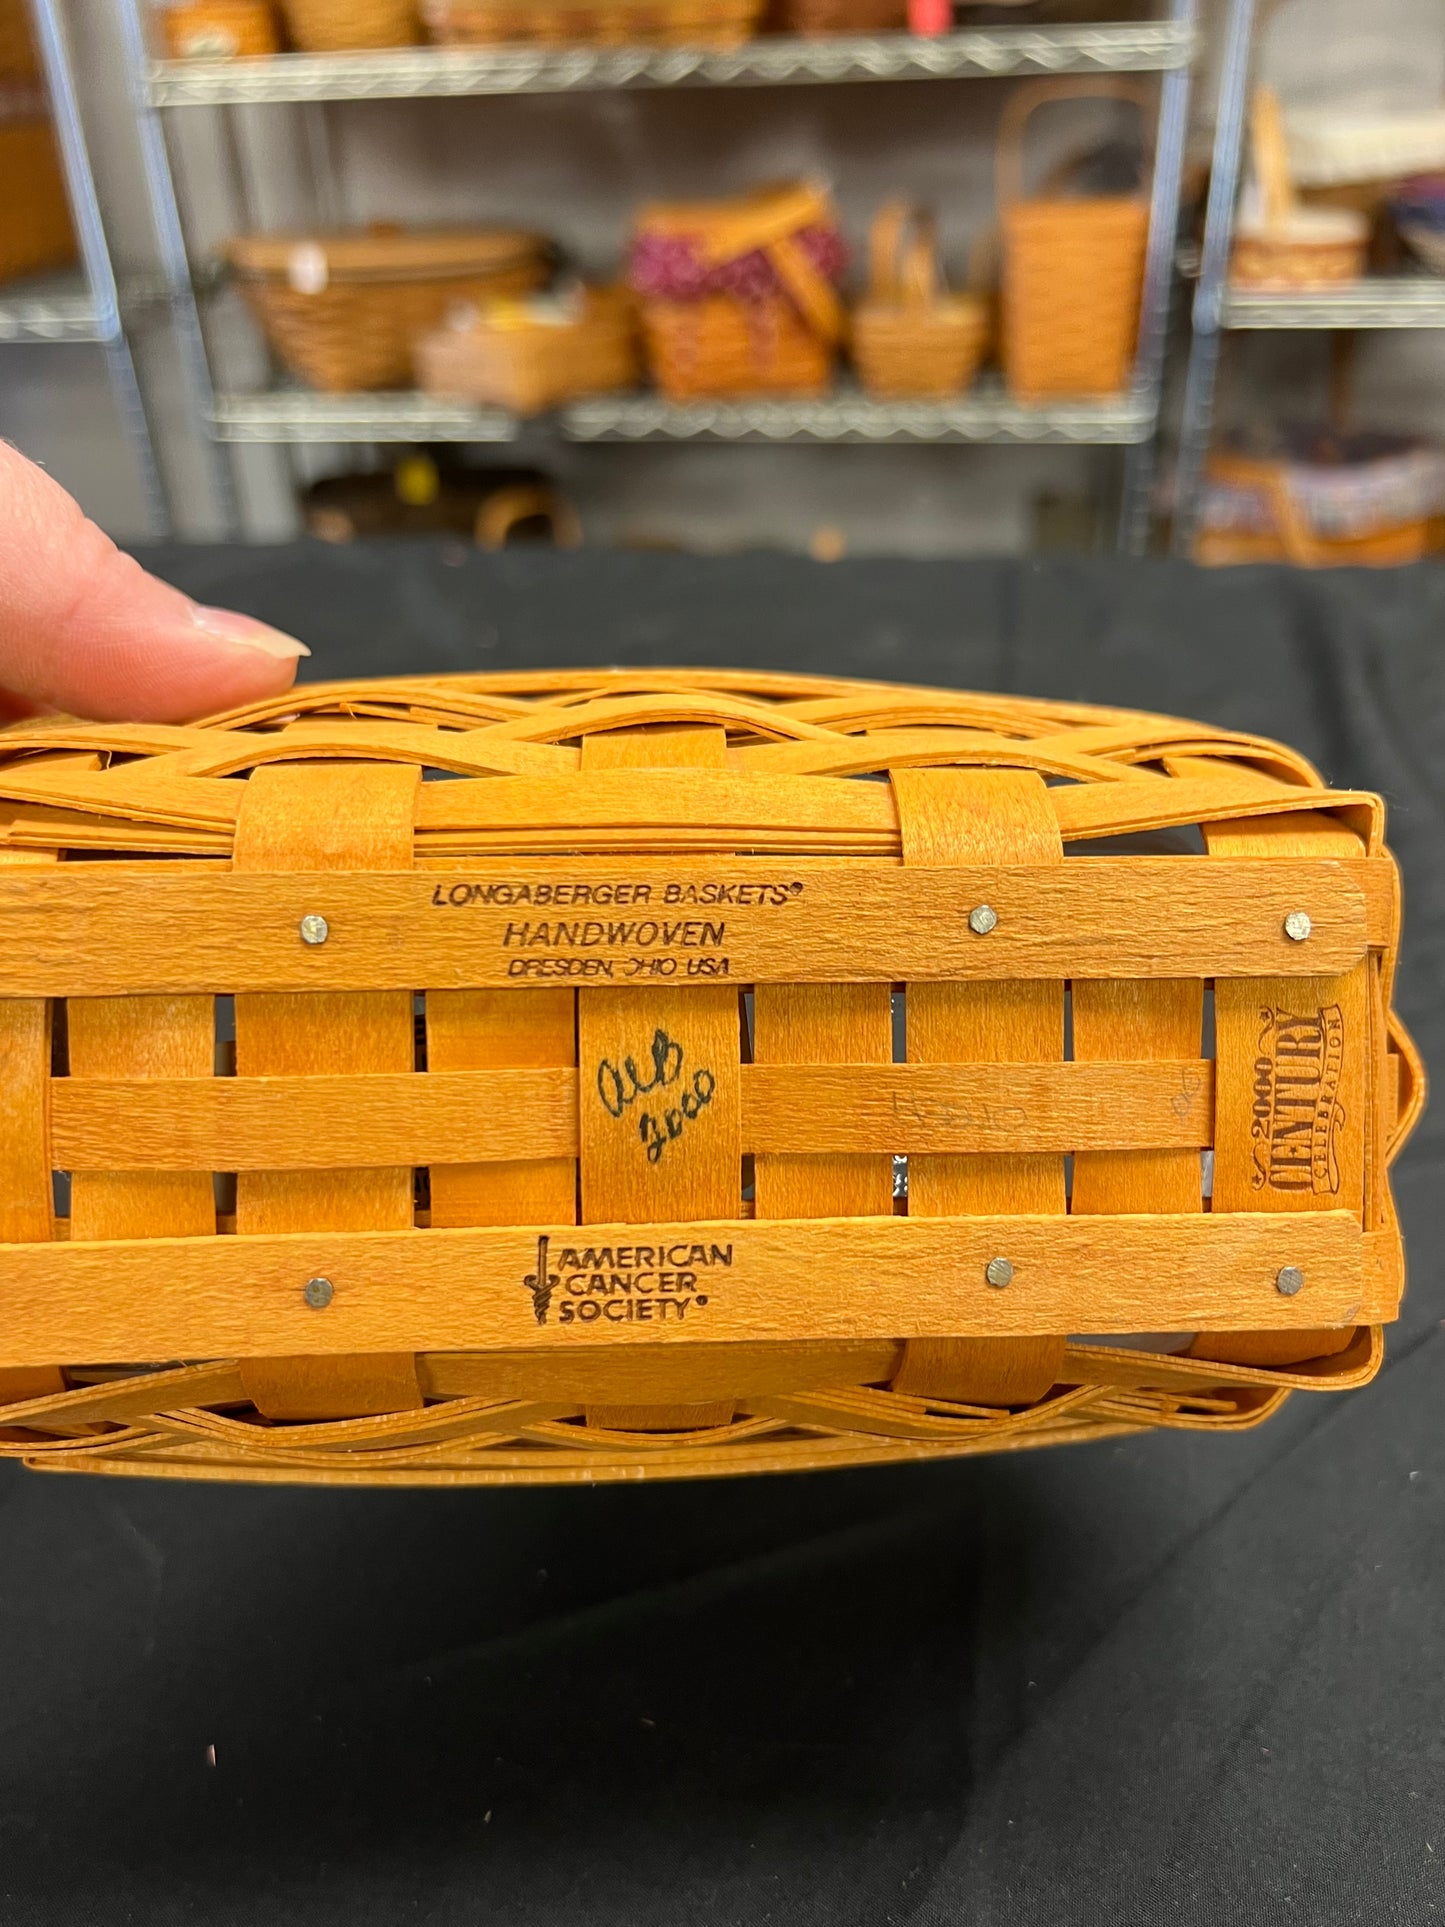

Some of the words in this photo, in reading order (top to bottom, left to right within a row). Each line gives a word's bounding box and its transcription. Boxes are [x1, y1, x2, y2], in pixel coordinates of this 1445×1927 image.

[432, 884, 652, 907] LONGABERGER
[503, 920, 726, 947] HANDWOVEN
[687, 957, 730, 976] USA
[1251, 1057, 1273, 1139] 2000
[1268, 1007, 1323, 1191] CENTURY
[1313, 1018, 1342, 1180] CELEBRATION
[558, 1244, 733, 1271] AMERICAN
[565, 1271, 698, 1295] CANCER
